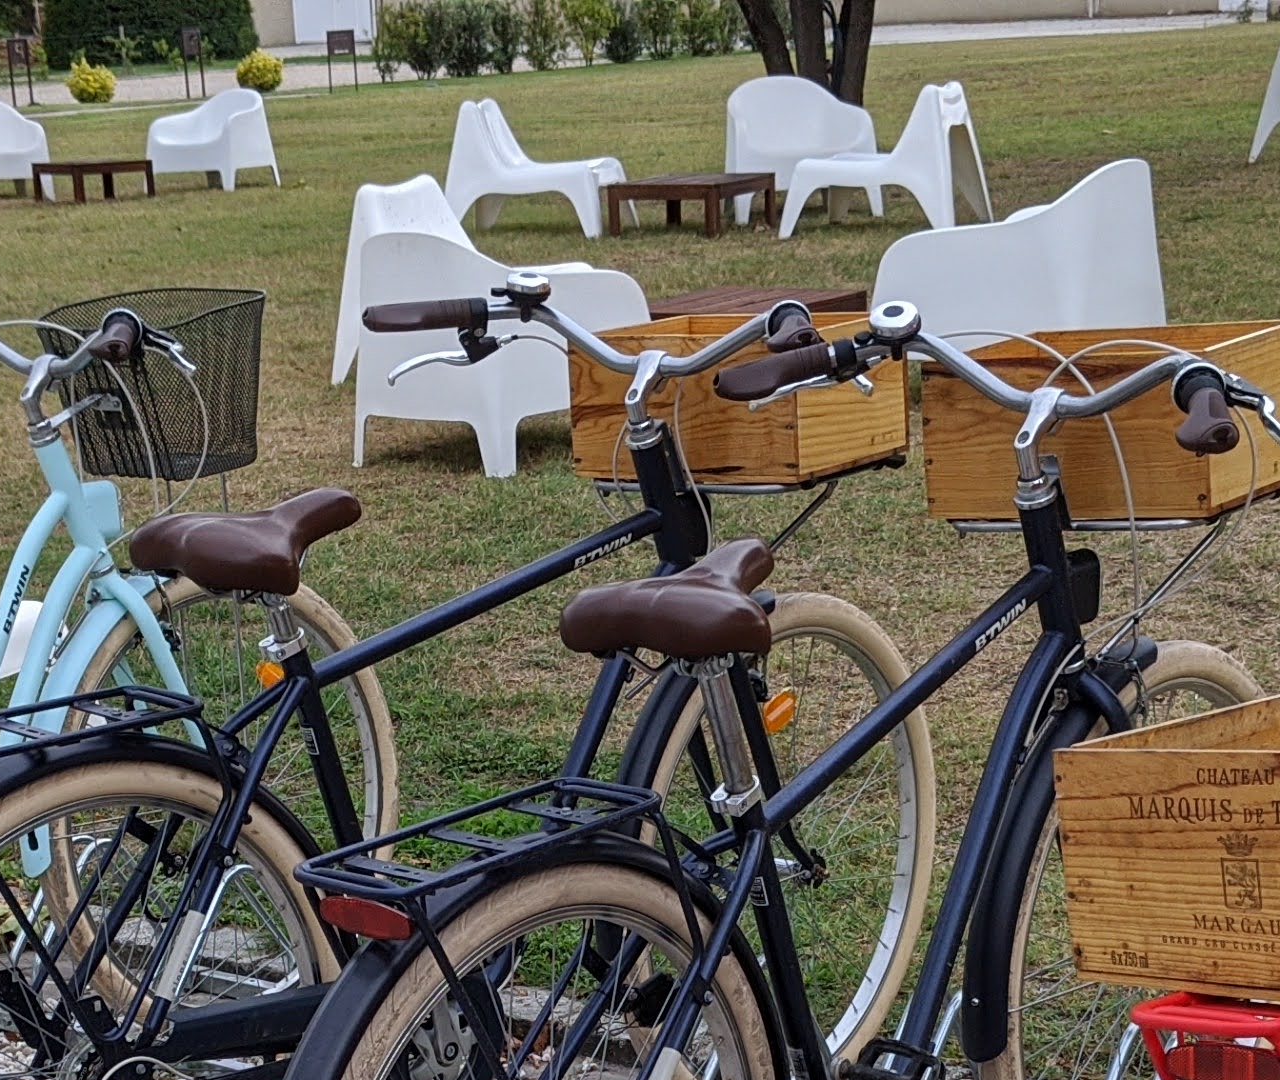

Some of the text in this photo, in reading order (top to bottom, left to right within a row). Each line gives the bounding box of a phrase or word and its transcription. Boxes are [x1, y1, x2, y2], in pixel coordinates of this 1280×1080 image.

[574, 532, 633, 569] BTWIN
[3, 564, 30, 635] BTWIN
[975, 598, 1027, 652] BTWIN
[1196, 768, 1275, 786] CHATEAU
[1128, 796, 1233, 825] MARQUIS
[1243, 808, 1264, 825] DE
[1162, 934, 1198, 946] GRAND
[1204, 938, 1226, 949] CRU
